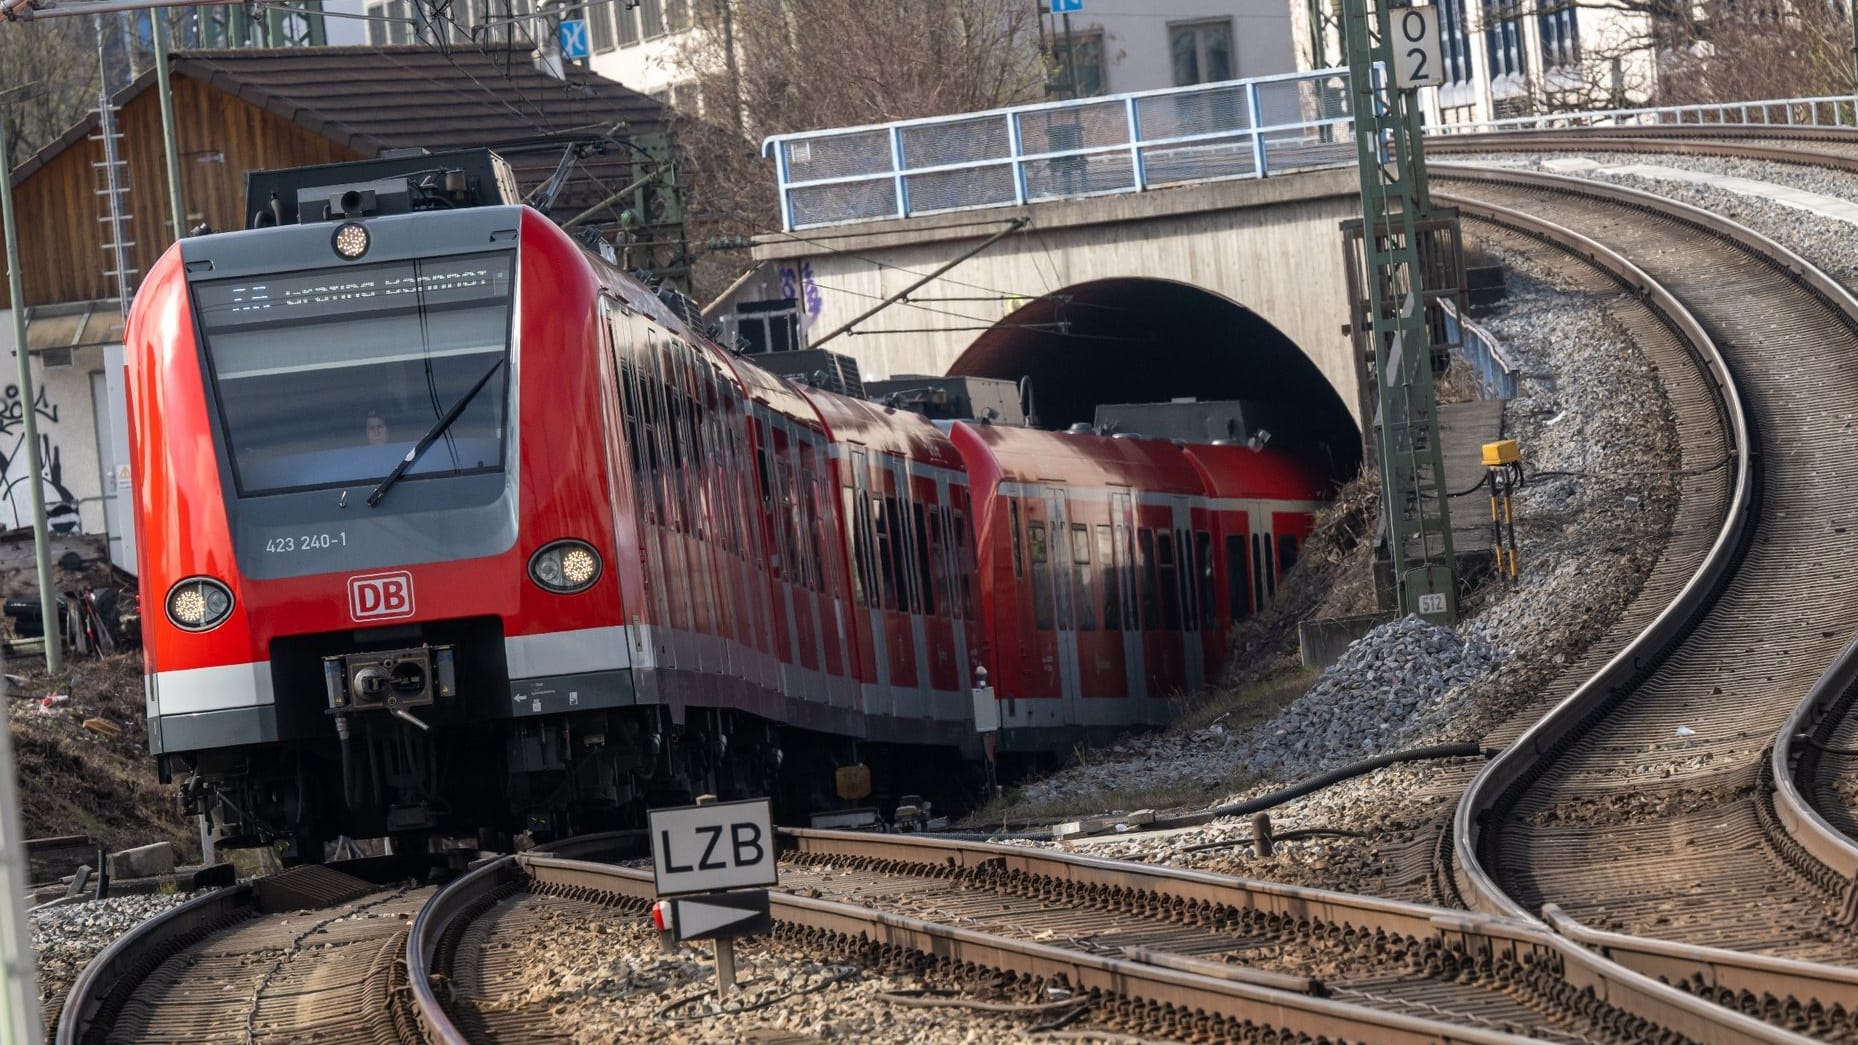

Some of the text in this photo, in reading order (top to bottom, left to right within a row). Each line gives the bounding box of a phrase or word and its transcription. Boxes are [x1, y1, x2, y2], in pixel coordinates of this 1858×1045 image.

[1402, 10, 1426, 42] 0
[1406, 47, 1430, 81] 2
[266, 531, 347, 553] 423 240-1
[358, 580, 406, 613] DB
[1422, 595, 1443, 612] 512
[661, 822, 764, 874] LZB
